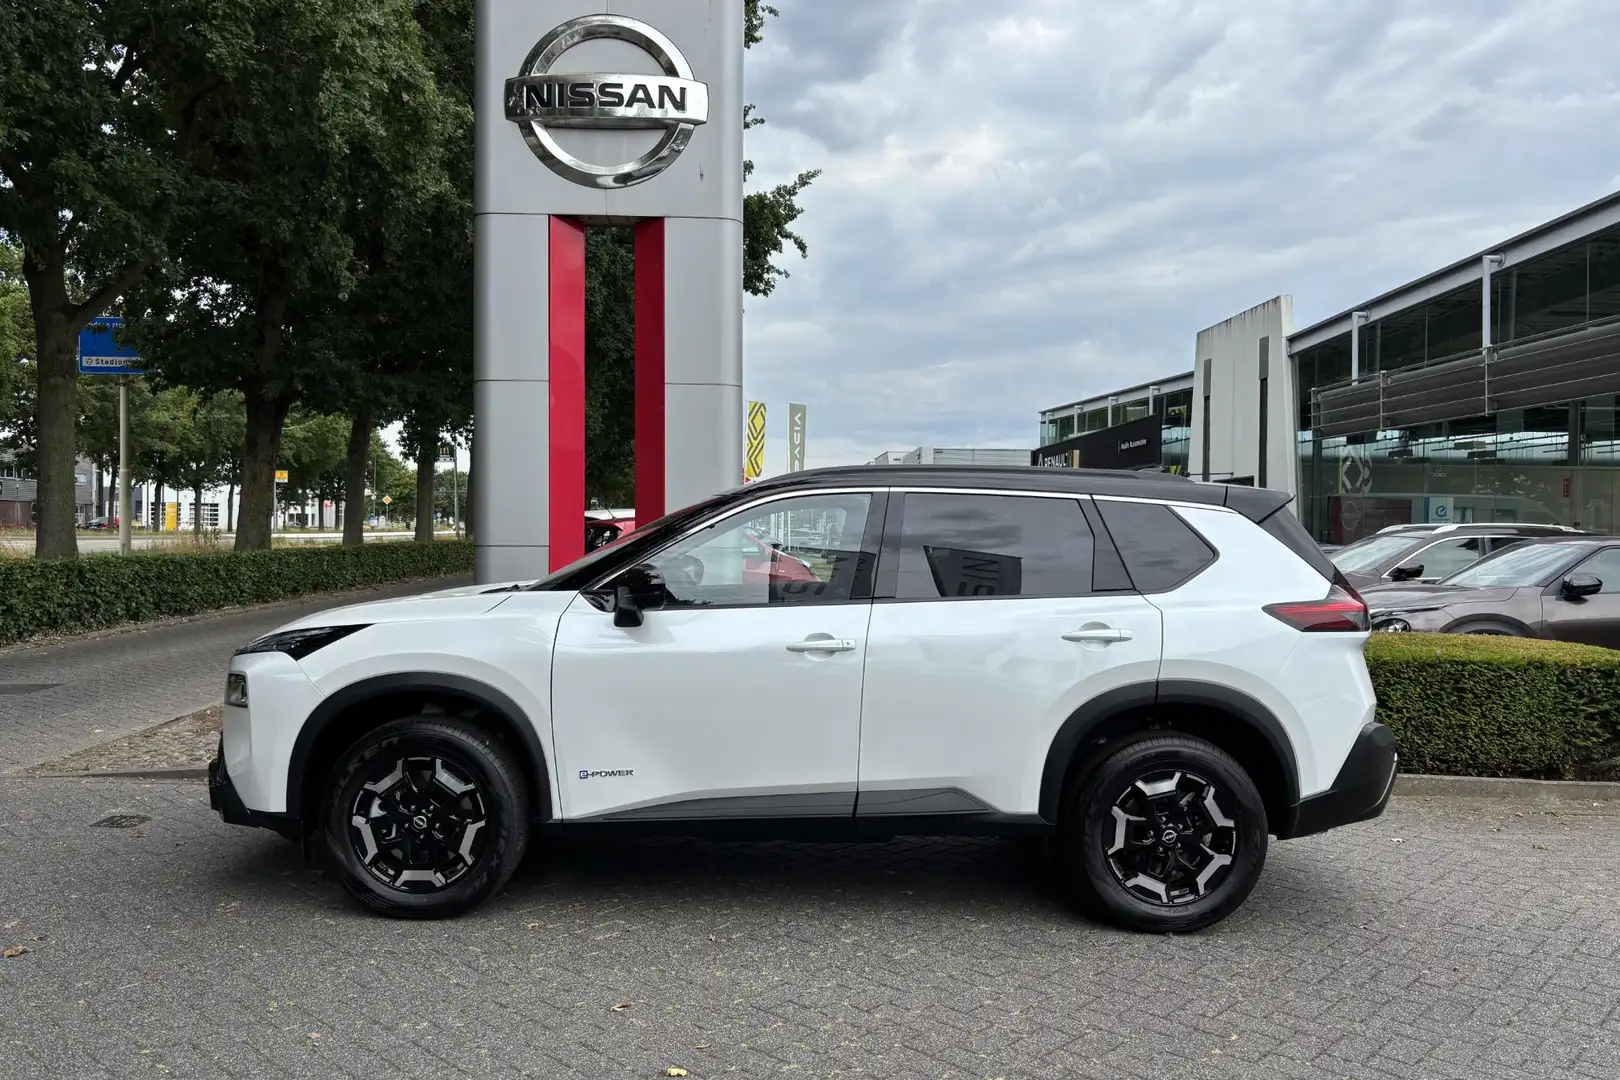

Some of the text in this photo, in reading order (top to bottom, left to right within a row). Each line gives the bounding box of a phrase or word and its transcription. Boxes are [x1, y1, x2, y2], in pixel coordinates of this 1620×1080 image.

[524, 82, 687, 112] NISSAN
[793, 412, 802, 472] DACIA
[579, 769, 634, 779] e-POWER
